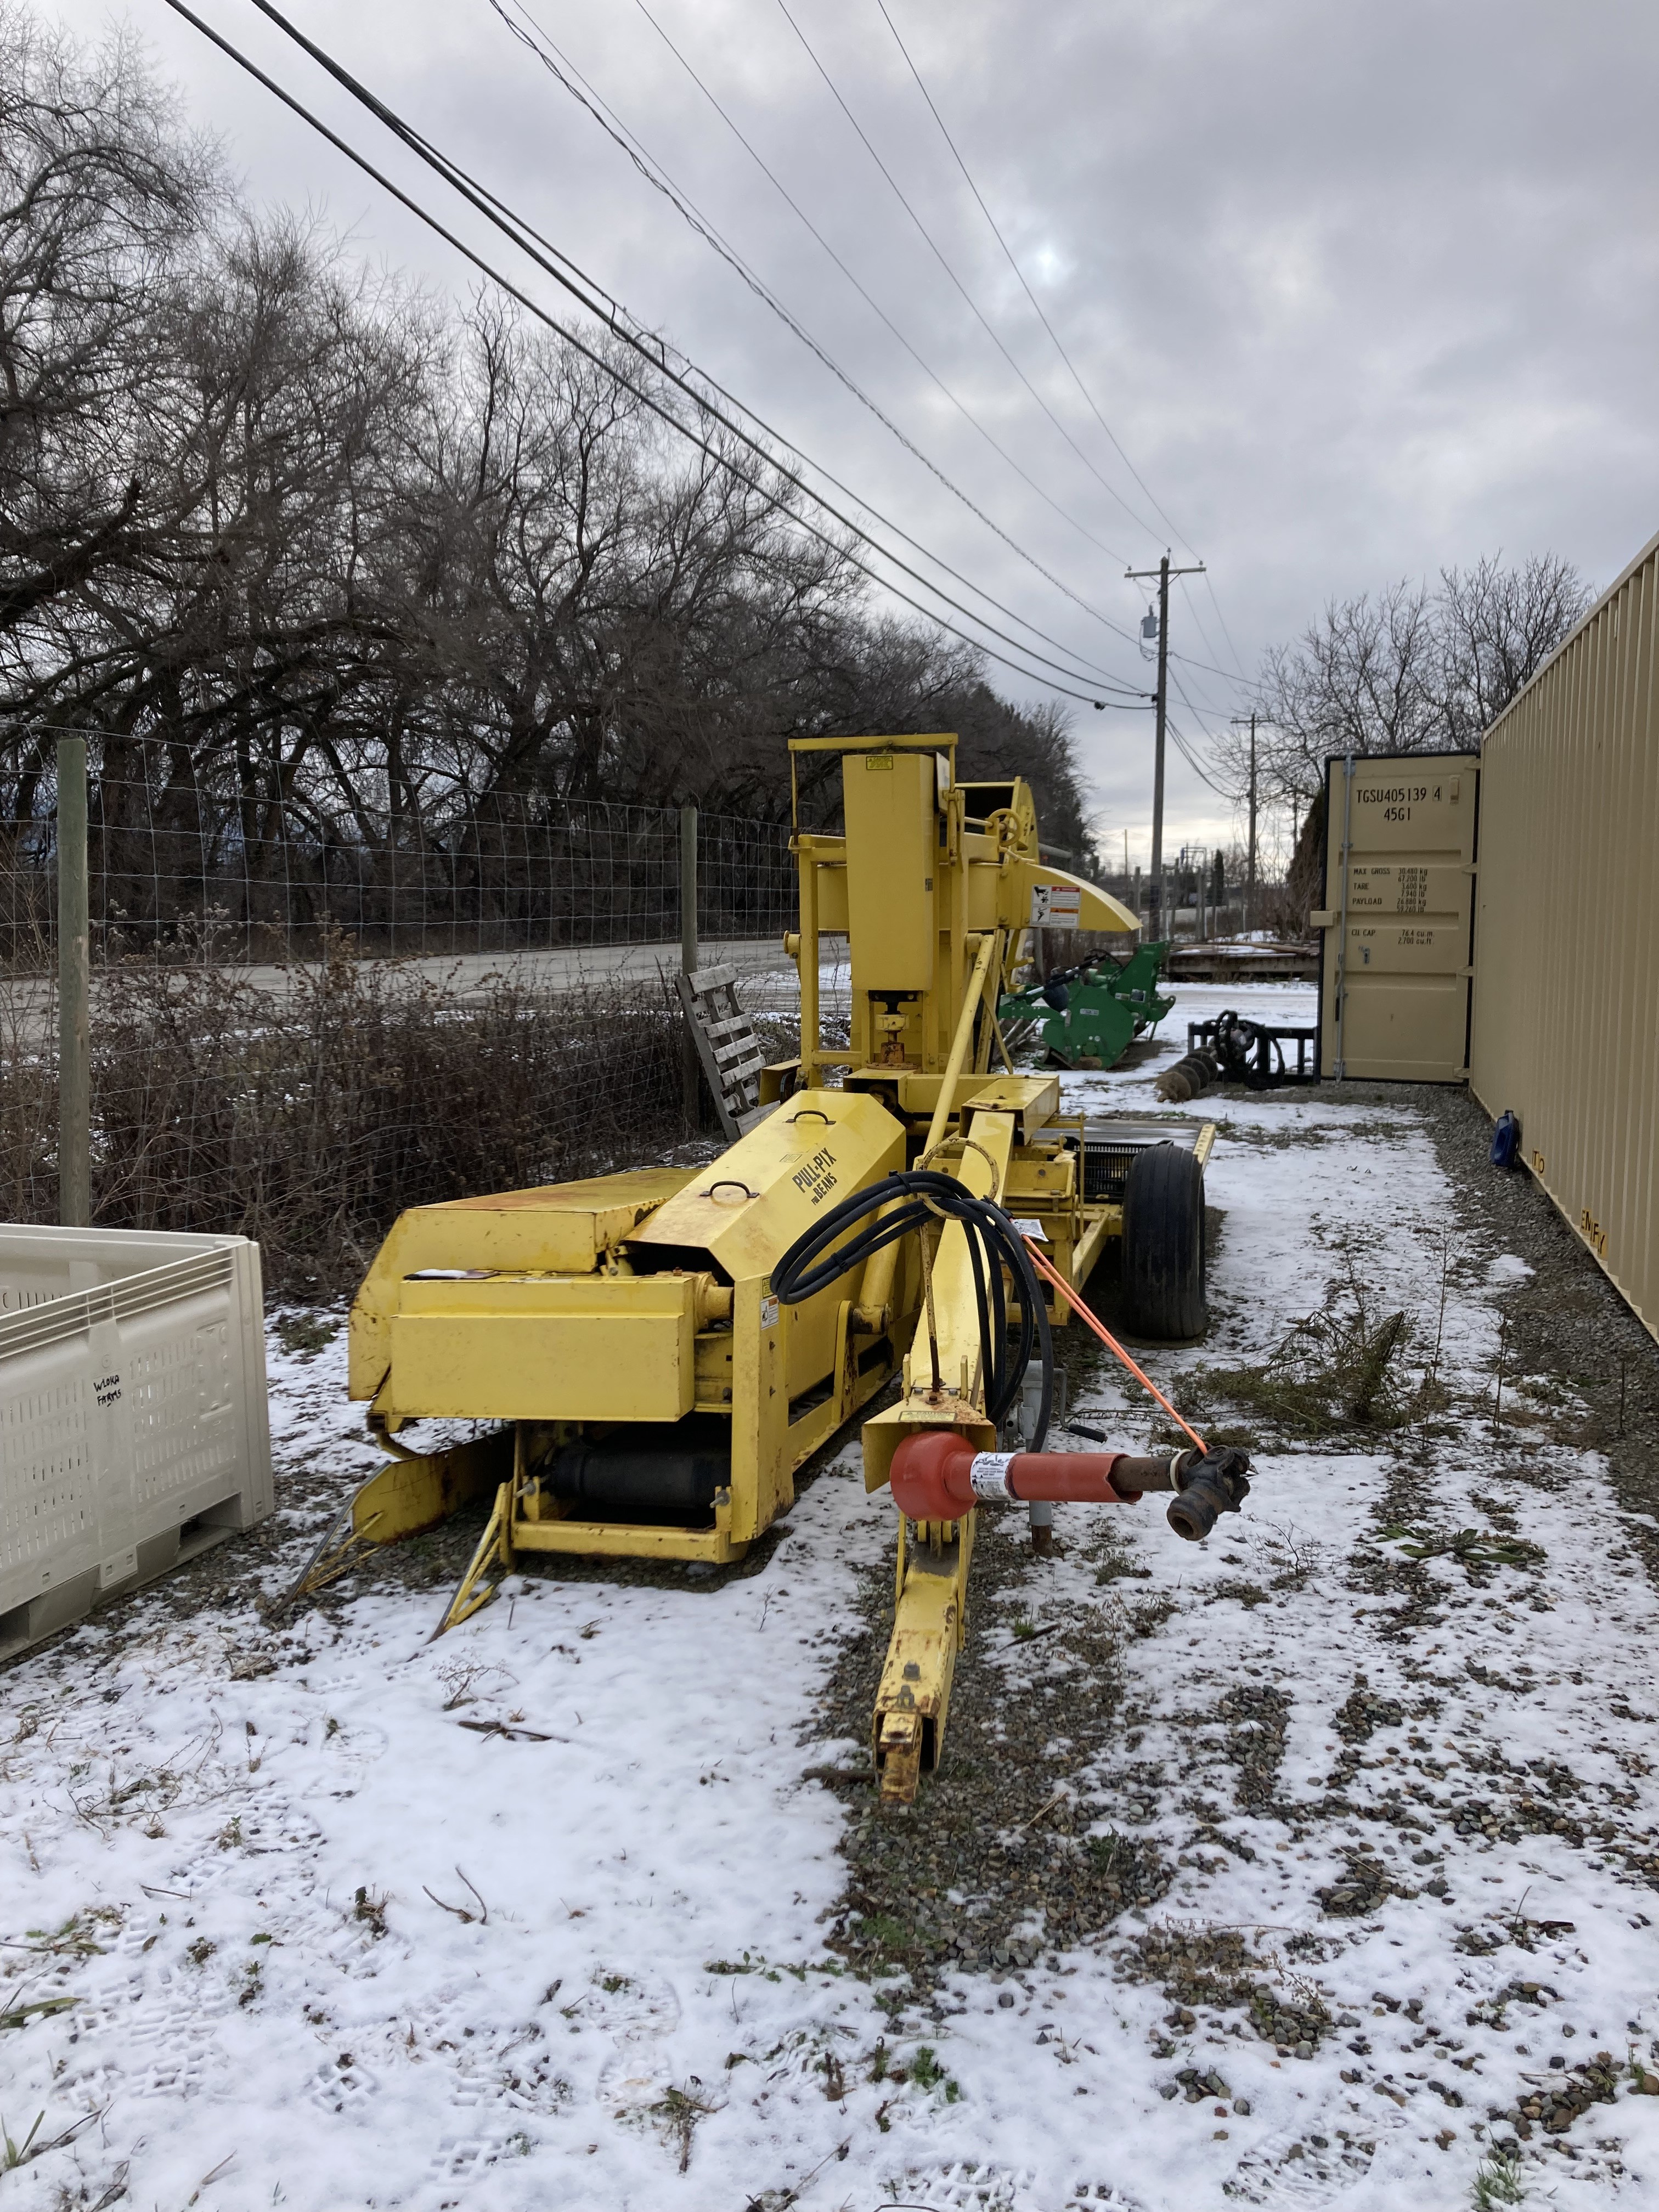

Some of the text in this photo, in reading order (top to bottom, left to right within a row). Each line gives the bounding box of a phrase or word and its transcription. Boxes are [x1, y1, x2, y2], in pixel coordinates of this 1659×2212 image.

[1357, 787, 1440, 803] TGSU405139 4
[1384, 807, 1410, 821] 45G1
[792, 1147, 837, 1193] PULL-PIX
[813, 1172, 837, 1199] BEANS
[97, 1389, 121, 1406] FARMS
